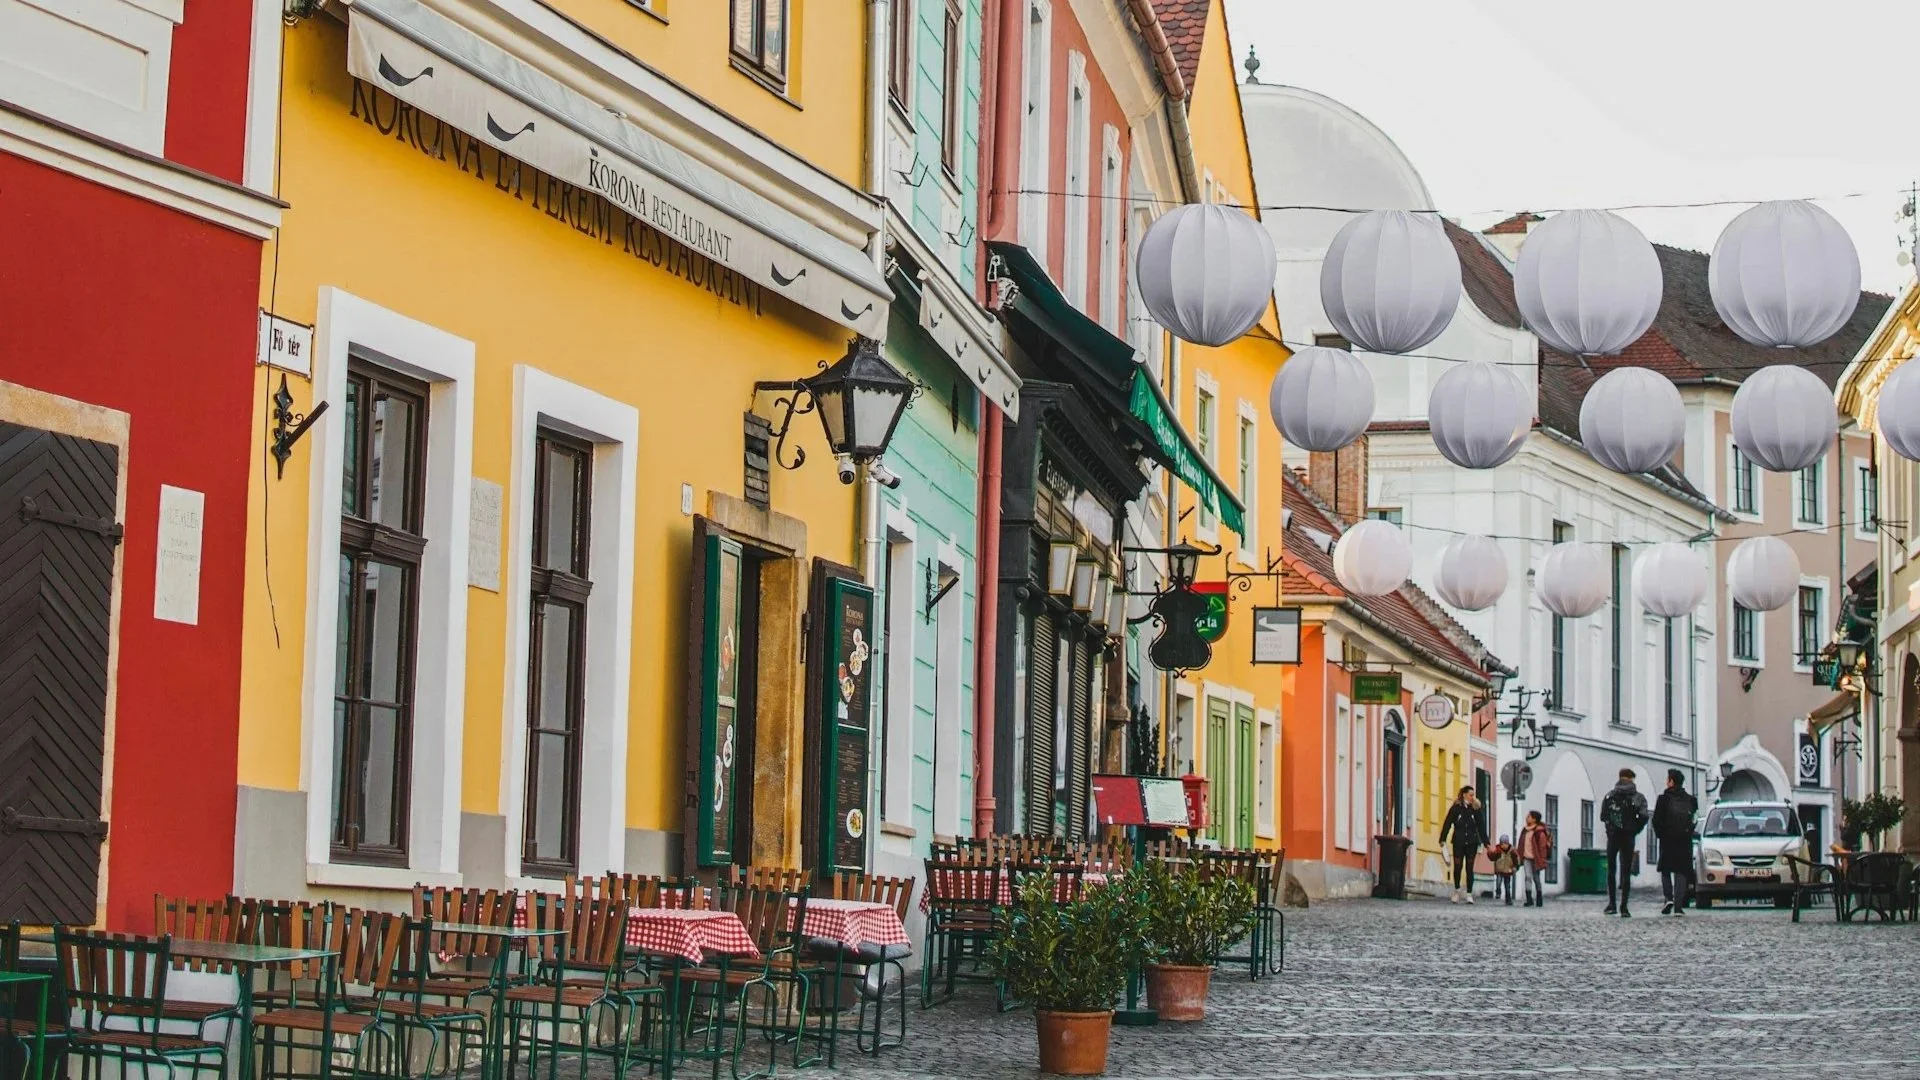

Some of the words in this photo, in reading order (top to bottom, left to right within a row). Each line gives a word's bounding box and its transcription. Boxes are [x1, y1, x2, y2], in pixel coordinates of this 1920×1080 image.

[588, 158, 647, 217] KORONA
[652, 195, 732, 262] RESTAURANT
[288, 334, 301, 357] tér
